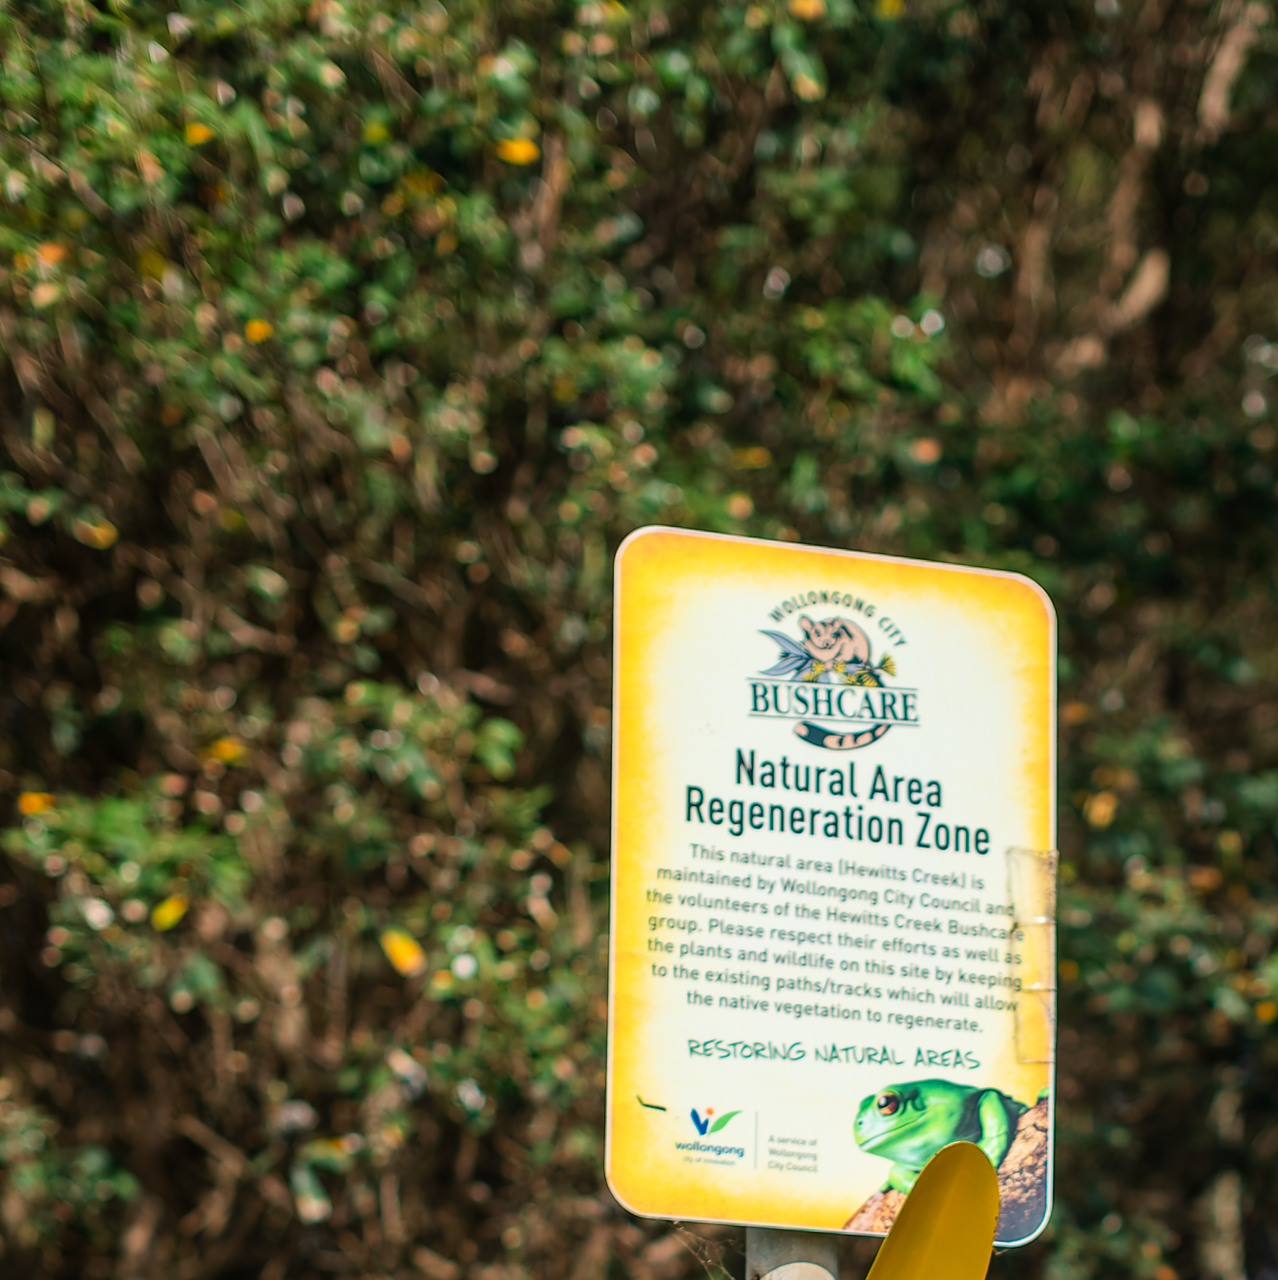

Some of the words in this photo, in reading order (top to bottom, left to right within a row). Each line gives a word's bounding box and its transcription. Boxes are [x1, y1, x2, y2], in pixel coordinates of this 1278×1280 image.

[768, 590, 877, 623] WOLLONGONG
[878, 617, 907, 647] CITY
[750, 682, 919, 723] BUSHCARE
[735, 748, 858, 798] Natural
[868, 764, 942, 808] Area
[685, 785, 904, 846] Regeneration
[916, 811, 990, 855] Zone
[690, 843, 725, 861] This
[730, 851, 791, 869] natural
[796, 858, 833, 873] area
[971, 874, 985, 890] is
[646, 888, 673, 904] the
[678, 893, 769, 915] volunteers
[773, 902, 790, 917] of
[795, 904, 821, 920] the
[827, 906, 889, 927] Hewitts
[894, 913, 943, 933] Creek
[948, 919, 1025, 942] Bushcare
[657, 867, 752, 889] maintained
[757, 875, 776, 894] by
[780, 877, 879, 905] Wollongong
[884, 888, 915, 909] City
[920, 892, 981, 913] Council
[986, 902, 1015, 917] and
[648, 915, 703, 935] group.
[708, 917, 765, 938] Please
[770, 928, 833, 946] respect
[838, 932, 878, 950] their
[882, 937, 937, 957] efforts
[942, 946, 960, 959] as
[965, 947, 1000, 963] well
[1004, 952, 1022, 965] as
[647, 938, 674, 954] the
[680, 941, 732, 960] plants
[737, 949, 768, 963] and
[773, 951, 835, 970] wildlife
[840, 959, 860, 972] on
[865, 959, 895, 976] this
[900, 963, 930, 979] site
[935, 966, 954, 985] by
[958, 968, 1022, 992] keeping
[651, 963, 668, 978] to
[672, 964, 700, 981] the
[704, 969, 771, 992] existing
[776, 977, 882, 999] paths/tracks
[886, 986, 935, 1004] which
[940, 991, 970, 1008] will
[974, 994, 1018, 1011] allow
[687, 990, 713, 1006] the
[719, 994, 769, 1011] native
[774, 1002, 862, 1020] vegetation
[867, 1008, 882, 1023] to
[887, 1011, 984, 1033] regenerate.
[687, 1038, 806, 1061] RESTORING
[814, 1043, 905, 1066] NATURAL
[914, 1046, 981, 1070] AREAS
[675, 1141, 744, 1158] wollongong
[768, 1134, 775, 1143] A
[777, 1136, 807, 1146] service
[808, 1138, 817, 1146] of
[768, 1148, 817, 1161] Wollongong
[768, 1160, 785, 1171] City
[786, 1161, 818, 1173] Council
